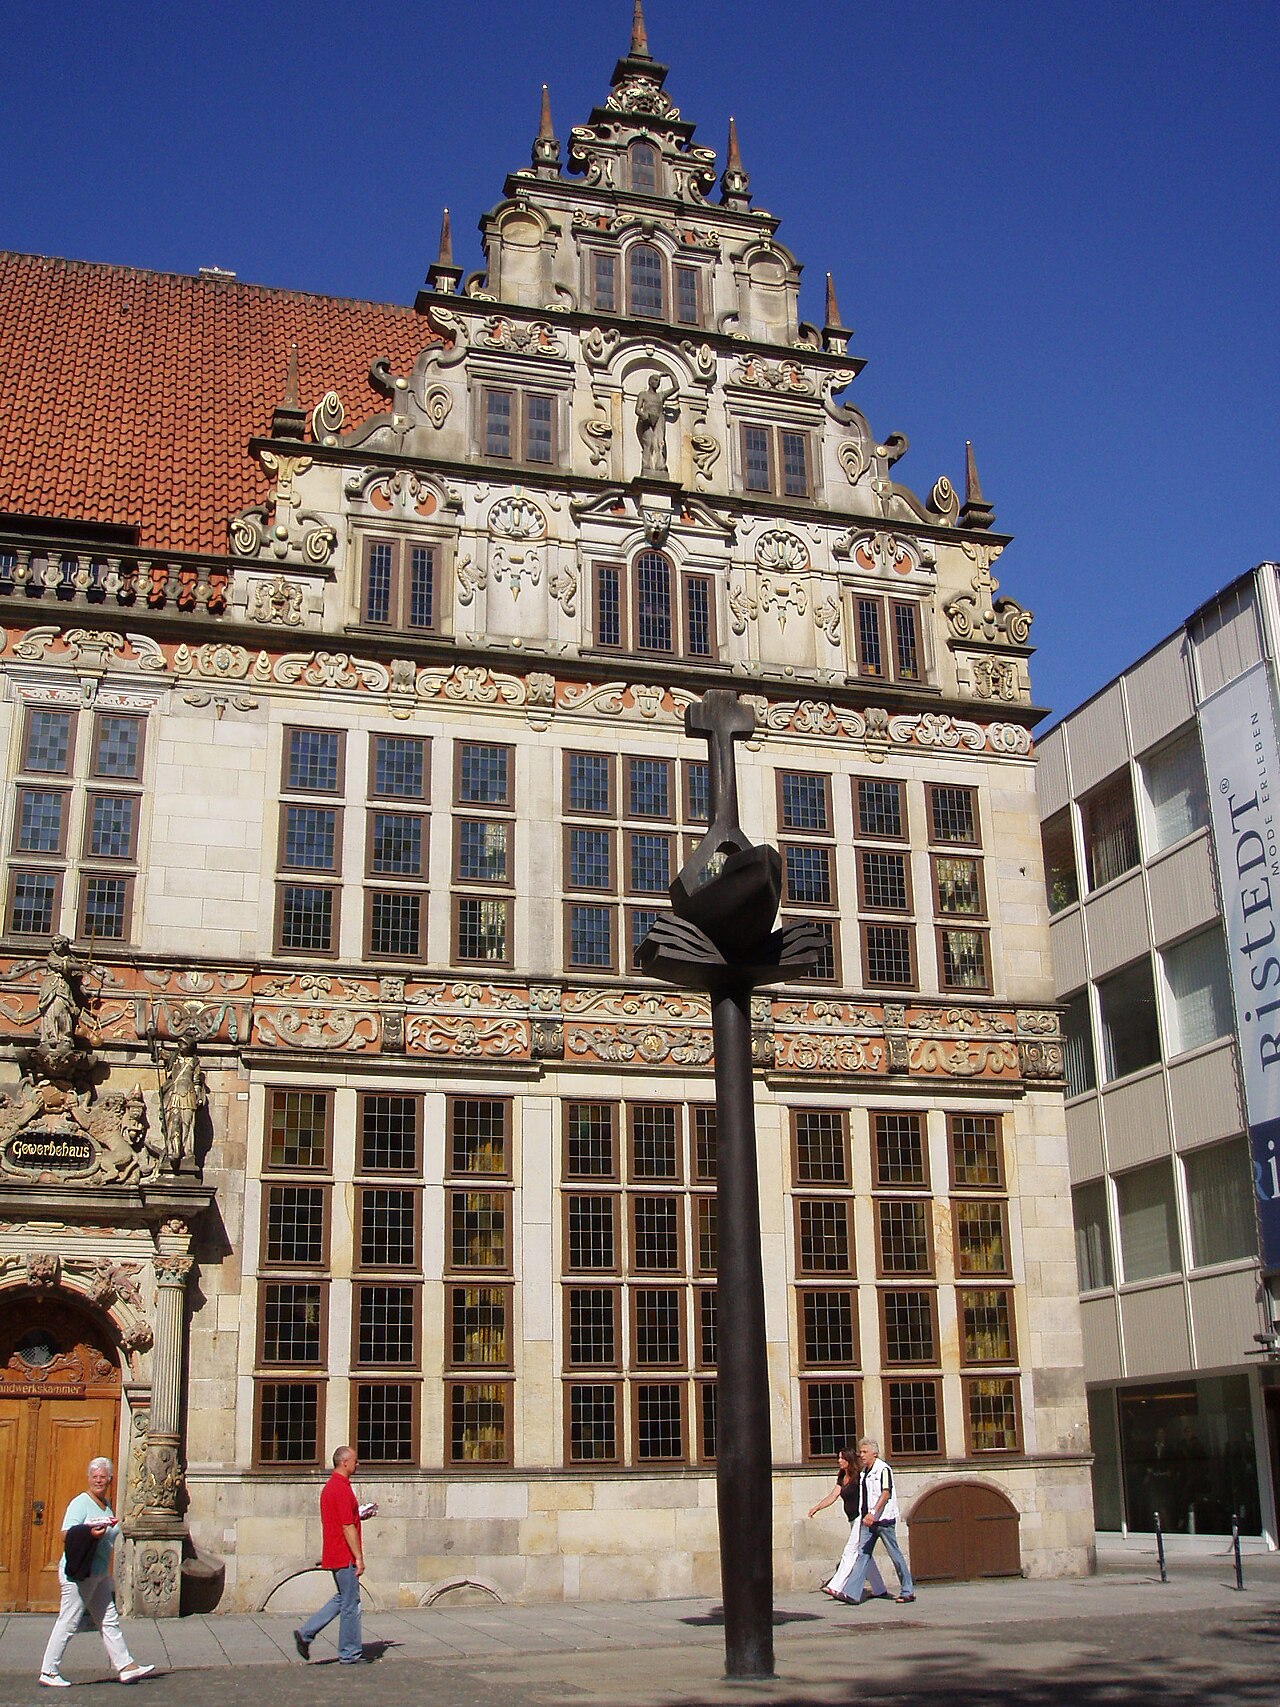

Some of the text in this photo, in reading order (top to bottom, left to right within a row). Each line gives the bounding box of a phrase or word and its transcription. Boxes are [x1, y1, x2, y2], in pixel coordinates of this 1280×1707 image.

[1250, 712, 1280, 876] MODE ERLEBEN
[12, 1140, 90, 1158] Gewerbehaus
